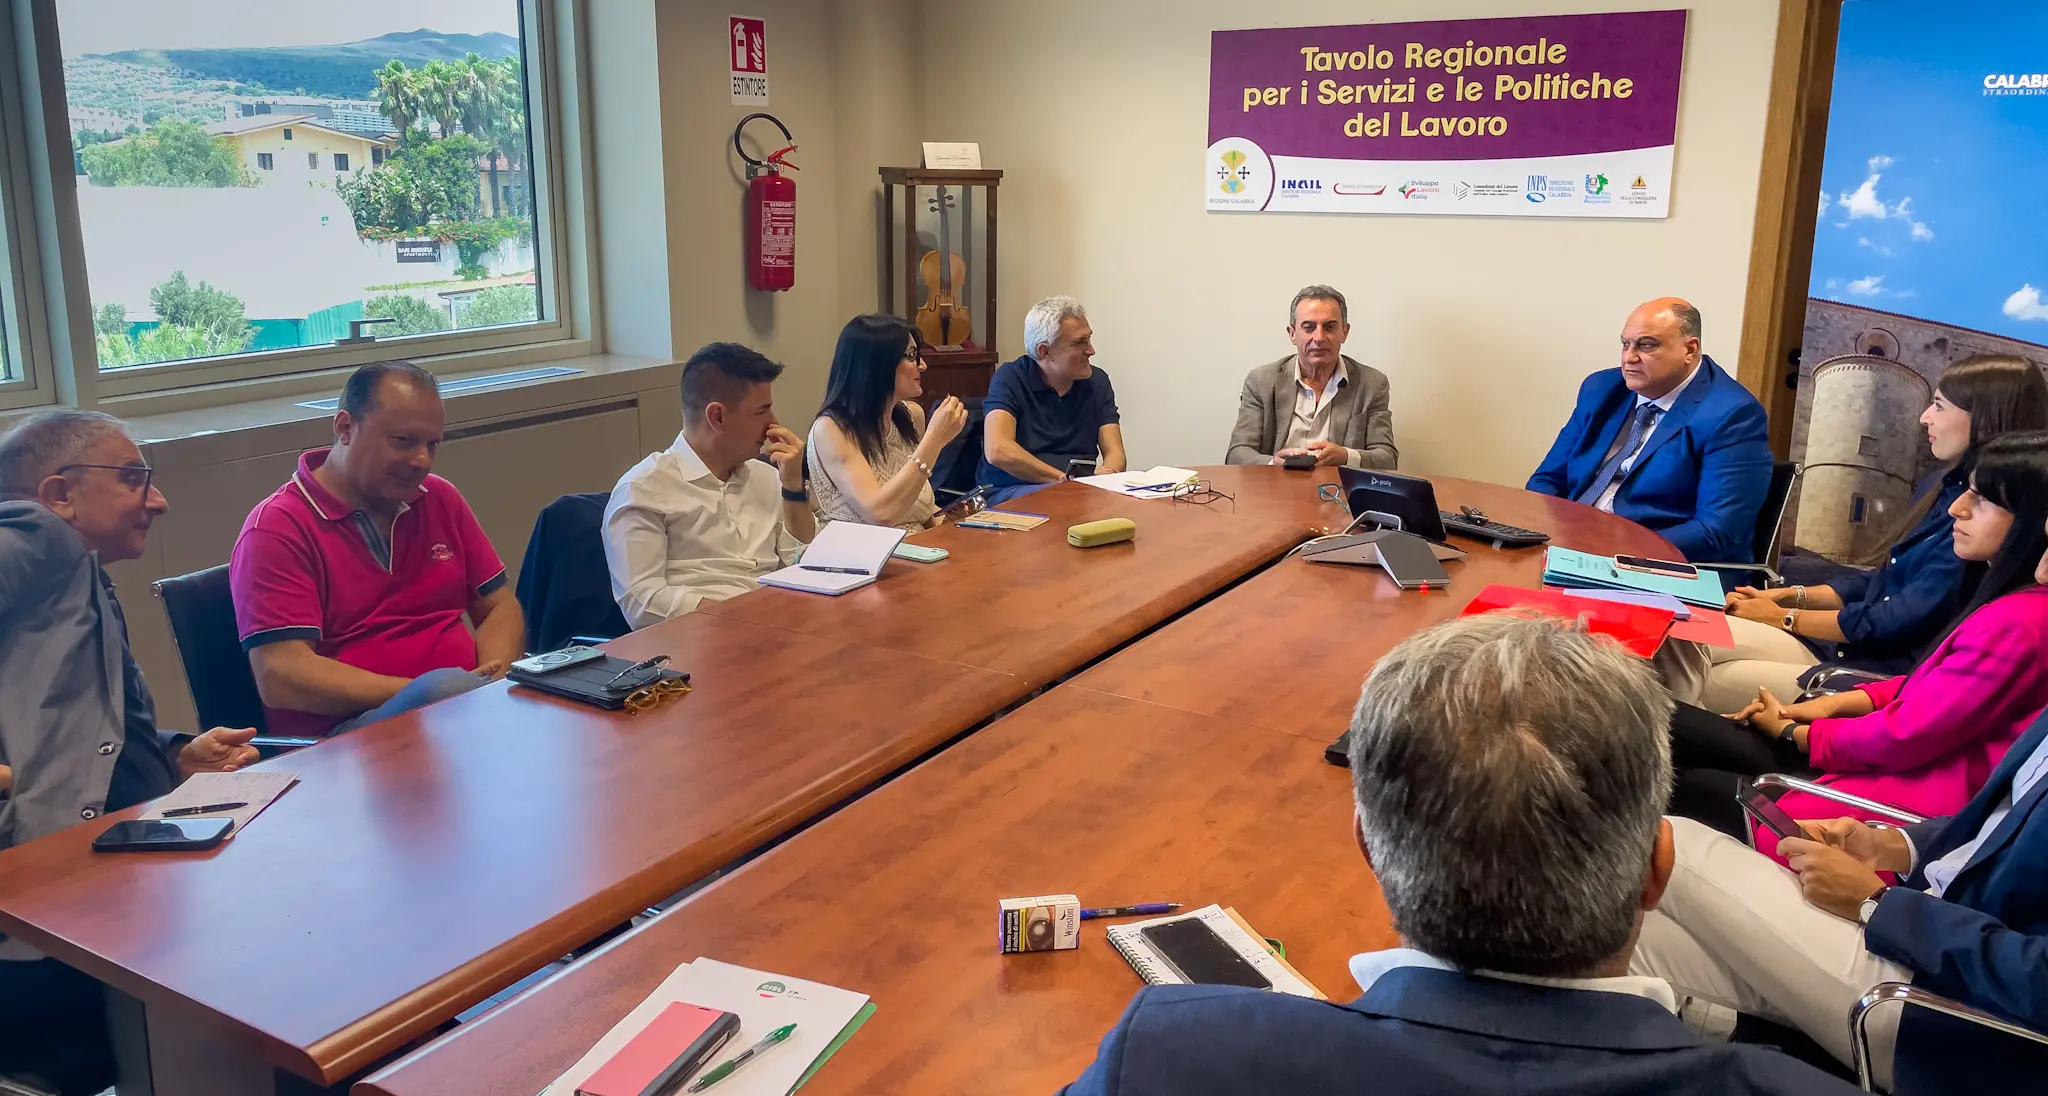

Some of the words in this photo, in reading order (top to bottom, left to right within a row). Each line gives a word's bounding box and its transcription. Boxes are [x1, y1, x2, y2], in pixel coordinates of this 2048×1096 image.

[1300, 44, 1394, 72] Tavolo
[1404, 37, 1567, 74] Regionale
[733, 76, 766, 97] ESTINTORE
[1243, 86, 1292, 112] per
[1300, 79, 1309, 105] i
[1317, 76, 1416, 105] Servizi
[1426, 82, 1445, 103] e
[1455, 75, 1484, 102] le
[1494, 71, 1634, 101] Politiche
[1343, 112, 1391, 137] del
[1400, 111, 1508, 137] Lavoro
[1281, 180, 1322, 189] INAIL
[1527, 175, 1547, 191] INPS
[1064, 908, 1074, 937] Winston
